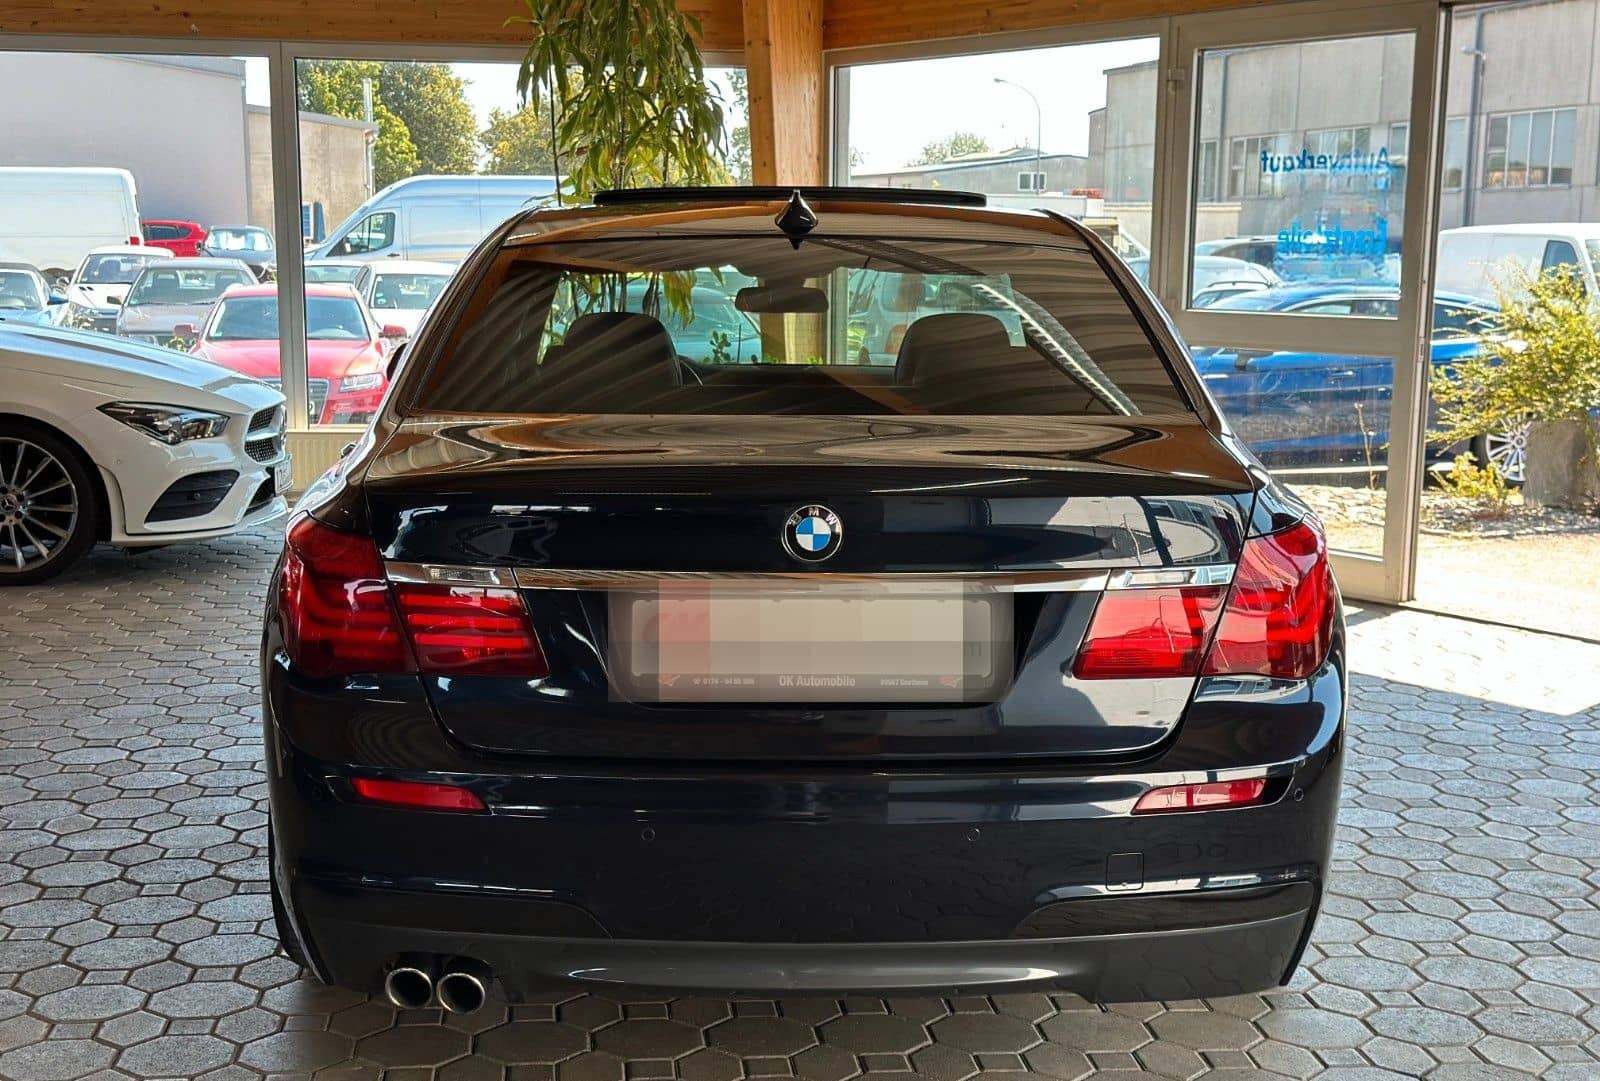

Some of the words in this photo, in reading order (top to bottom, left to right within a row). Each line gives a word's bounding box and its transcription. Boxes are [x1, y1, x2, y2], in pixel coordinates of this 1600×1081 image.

[788, 507, 837, 526] BMW
[779, 675, 794, 687] OK
[796, 675, 856, 687] Automobile
